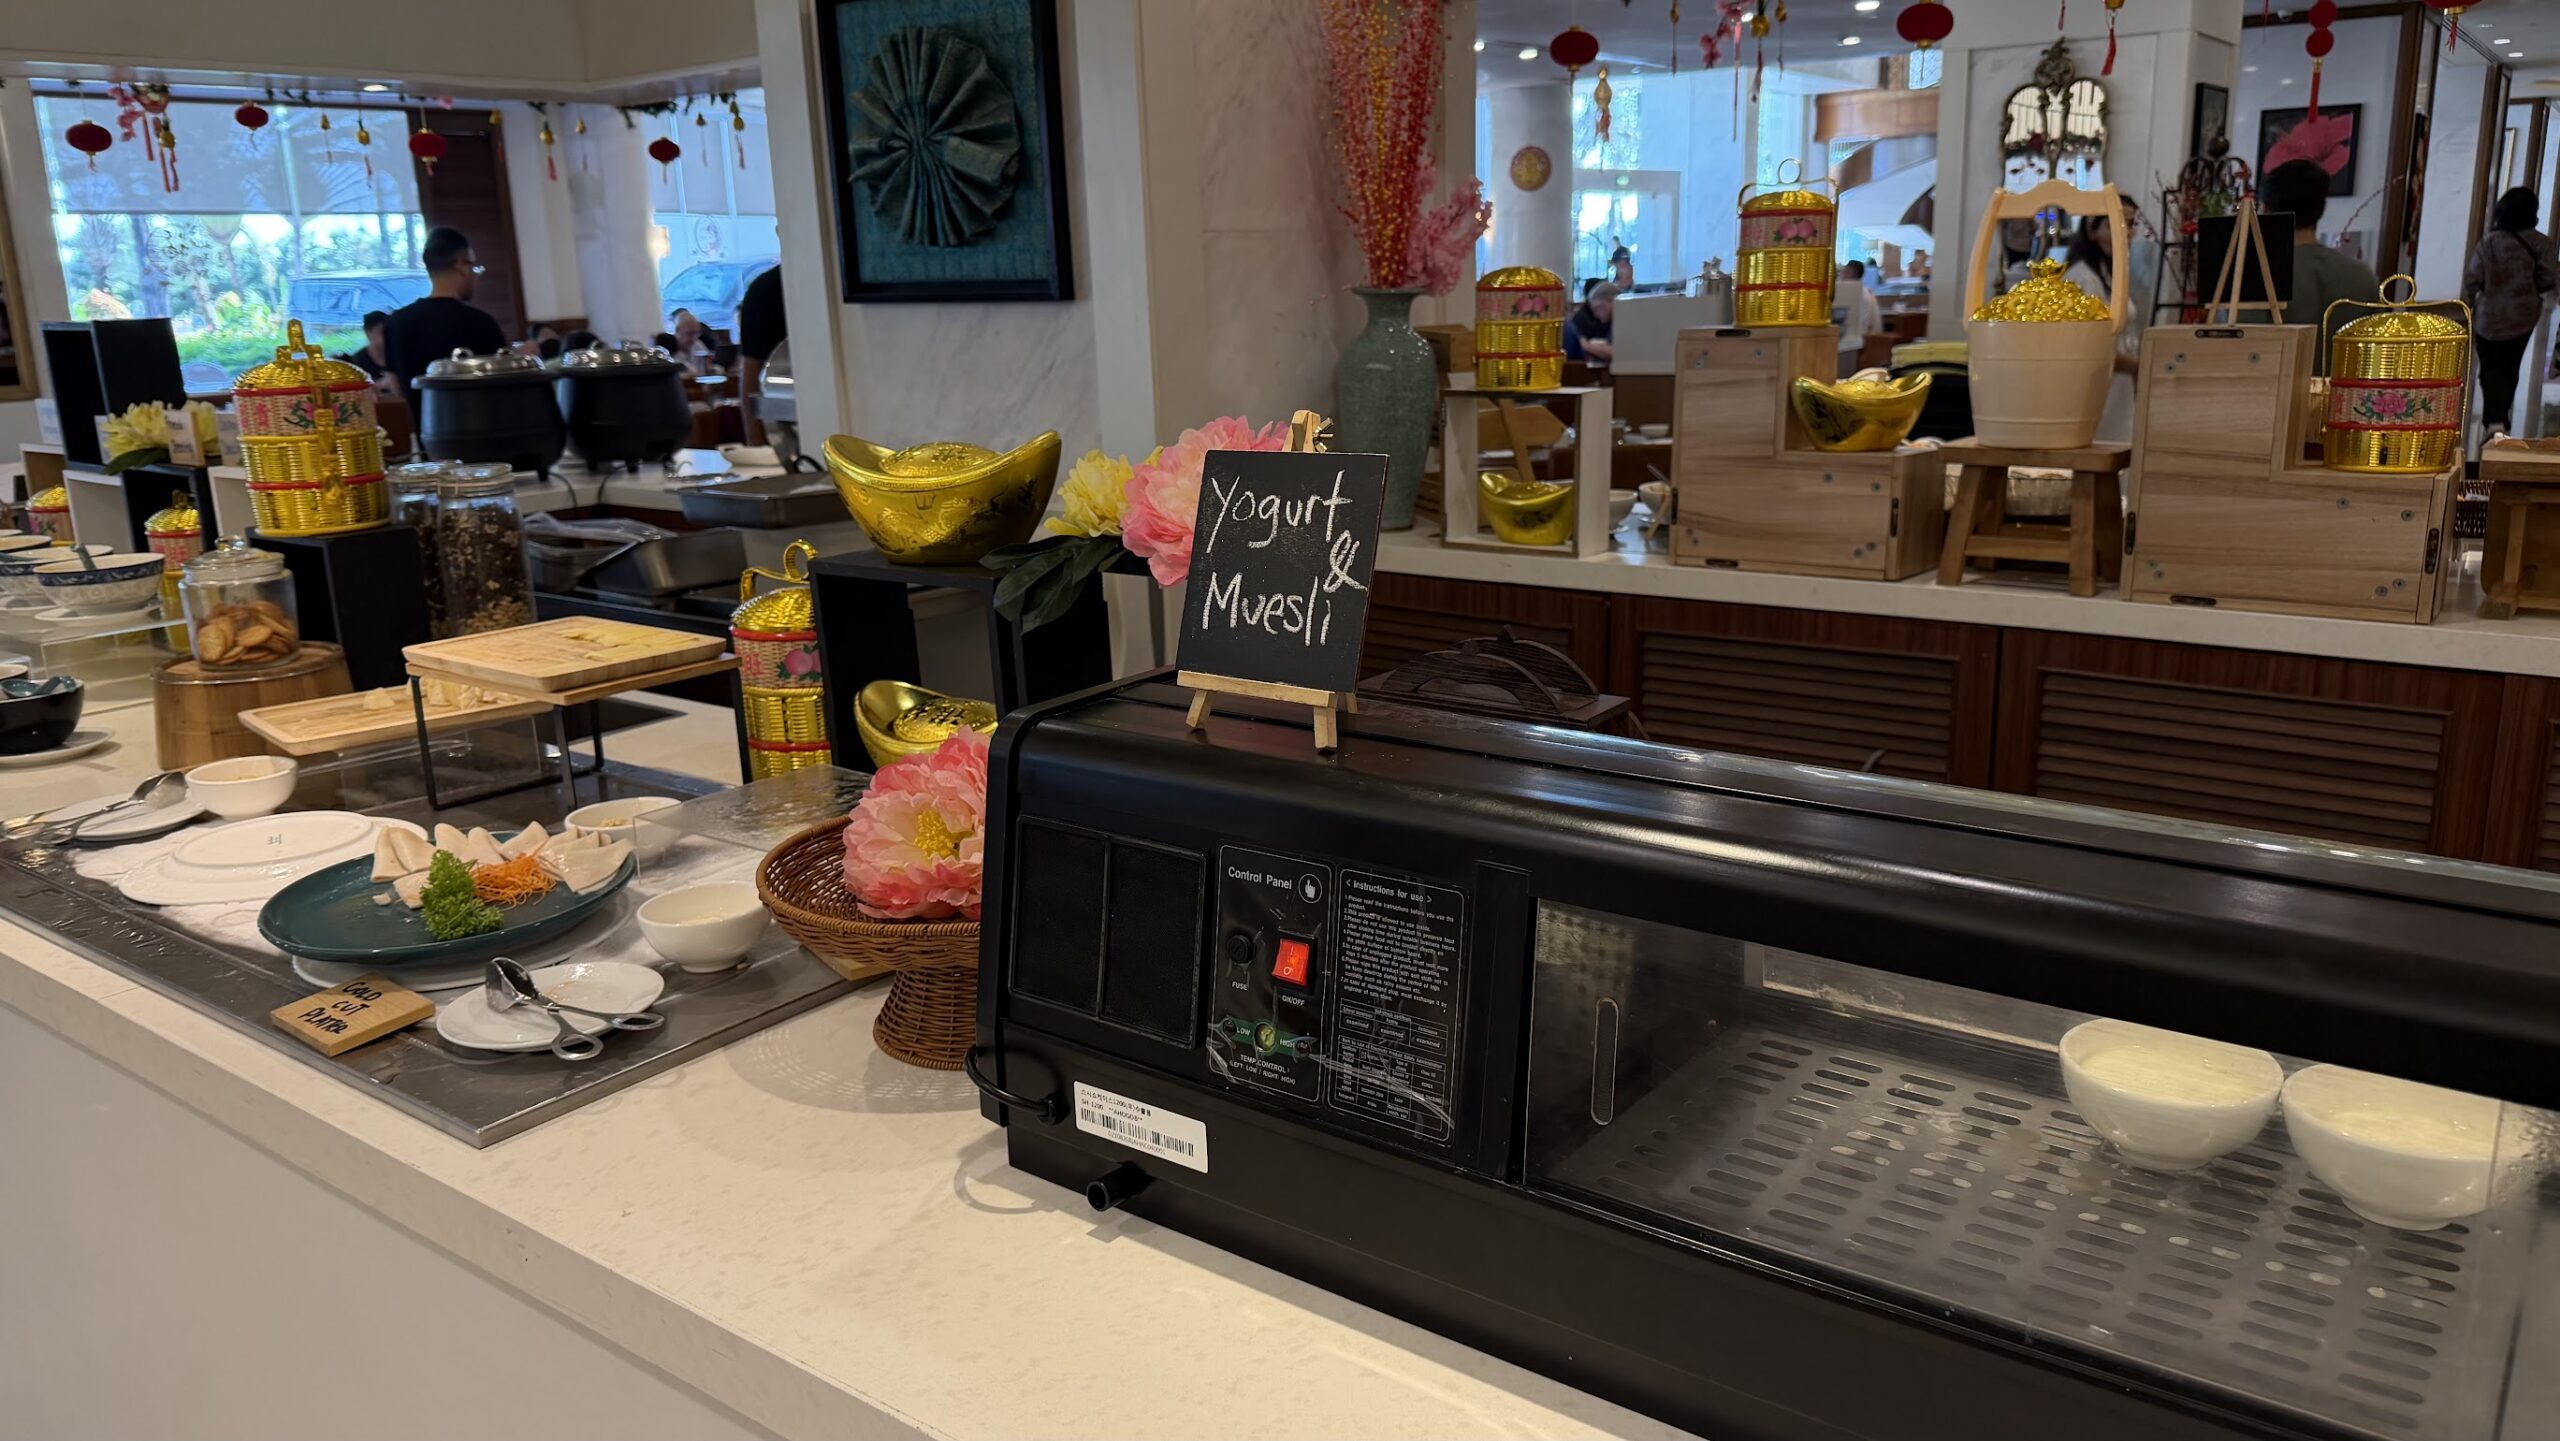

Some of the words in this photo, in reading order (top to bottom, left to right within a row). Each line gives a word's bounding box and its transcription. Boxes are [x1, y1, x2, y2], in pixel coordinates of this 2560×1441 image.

[1206, 469, 1353, 554] Yogurt
[1323, 529, 1368, 592] &
[1202, 570, 1332, 646] Muesli
[1227, 865, 1261, 883] Control
[1266, 874, 1292, 889] Panel
[1353, 880, 1394, 896] Instructions
[1397, 888, 1407, 898] for
[1410, 892, 1423, 902] use
[1232, 980, 1248, 991] FUSE
[1282, 994, 1305, 1006] ON/OFF
[331, 1001, 370, 1016] CUT
[1236, 1026, 1250, 1036] LOW
[1279, 1038, 1295, 1048] HIGH
[1246, 1064, 1257, 1073] LOW
